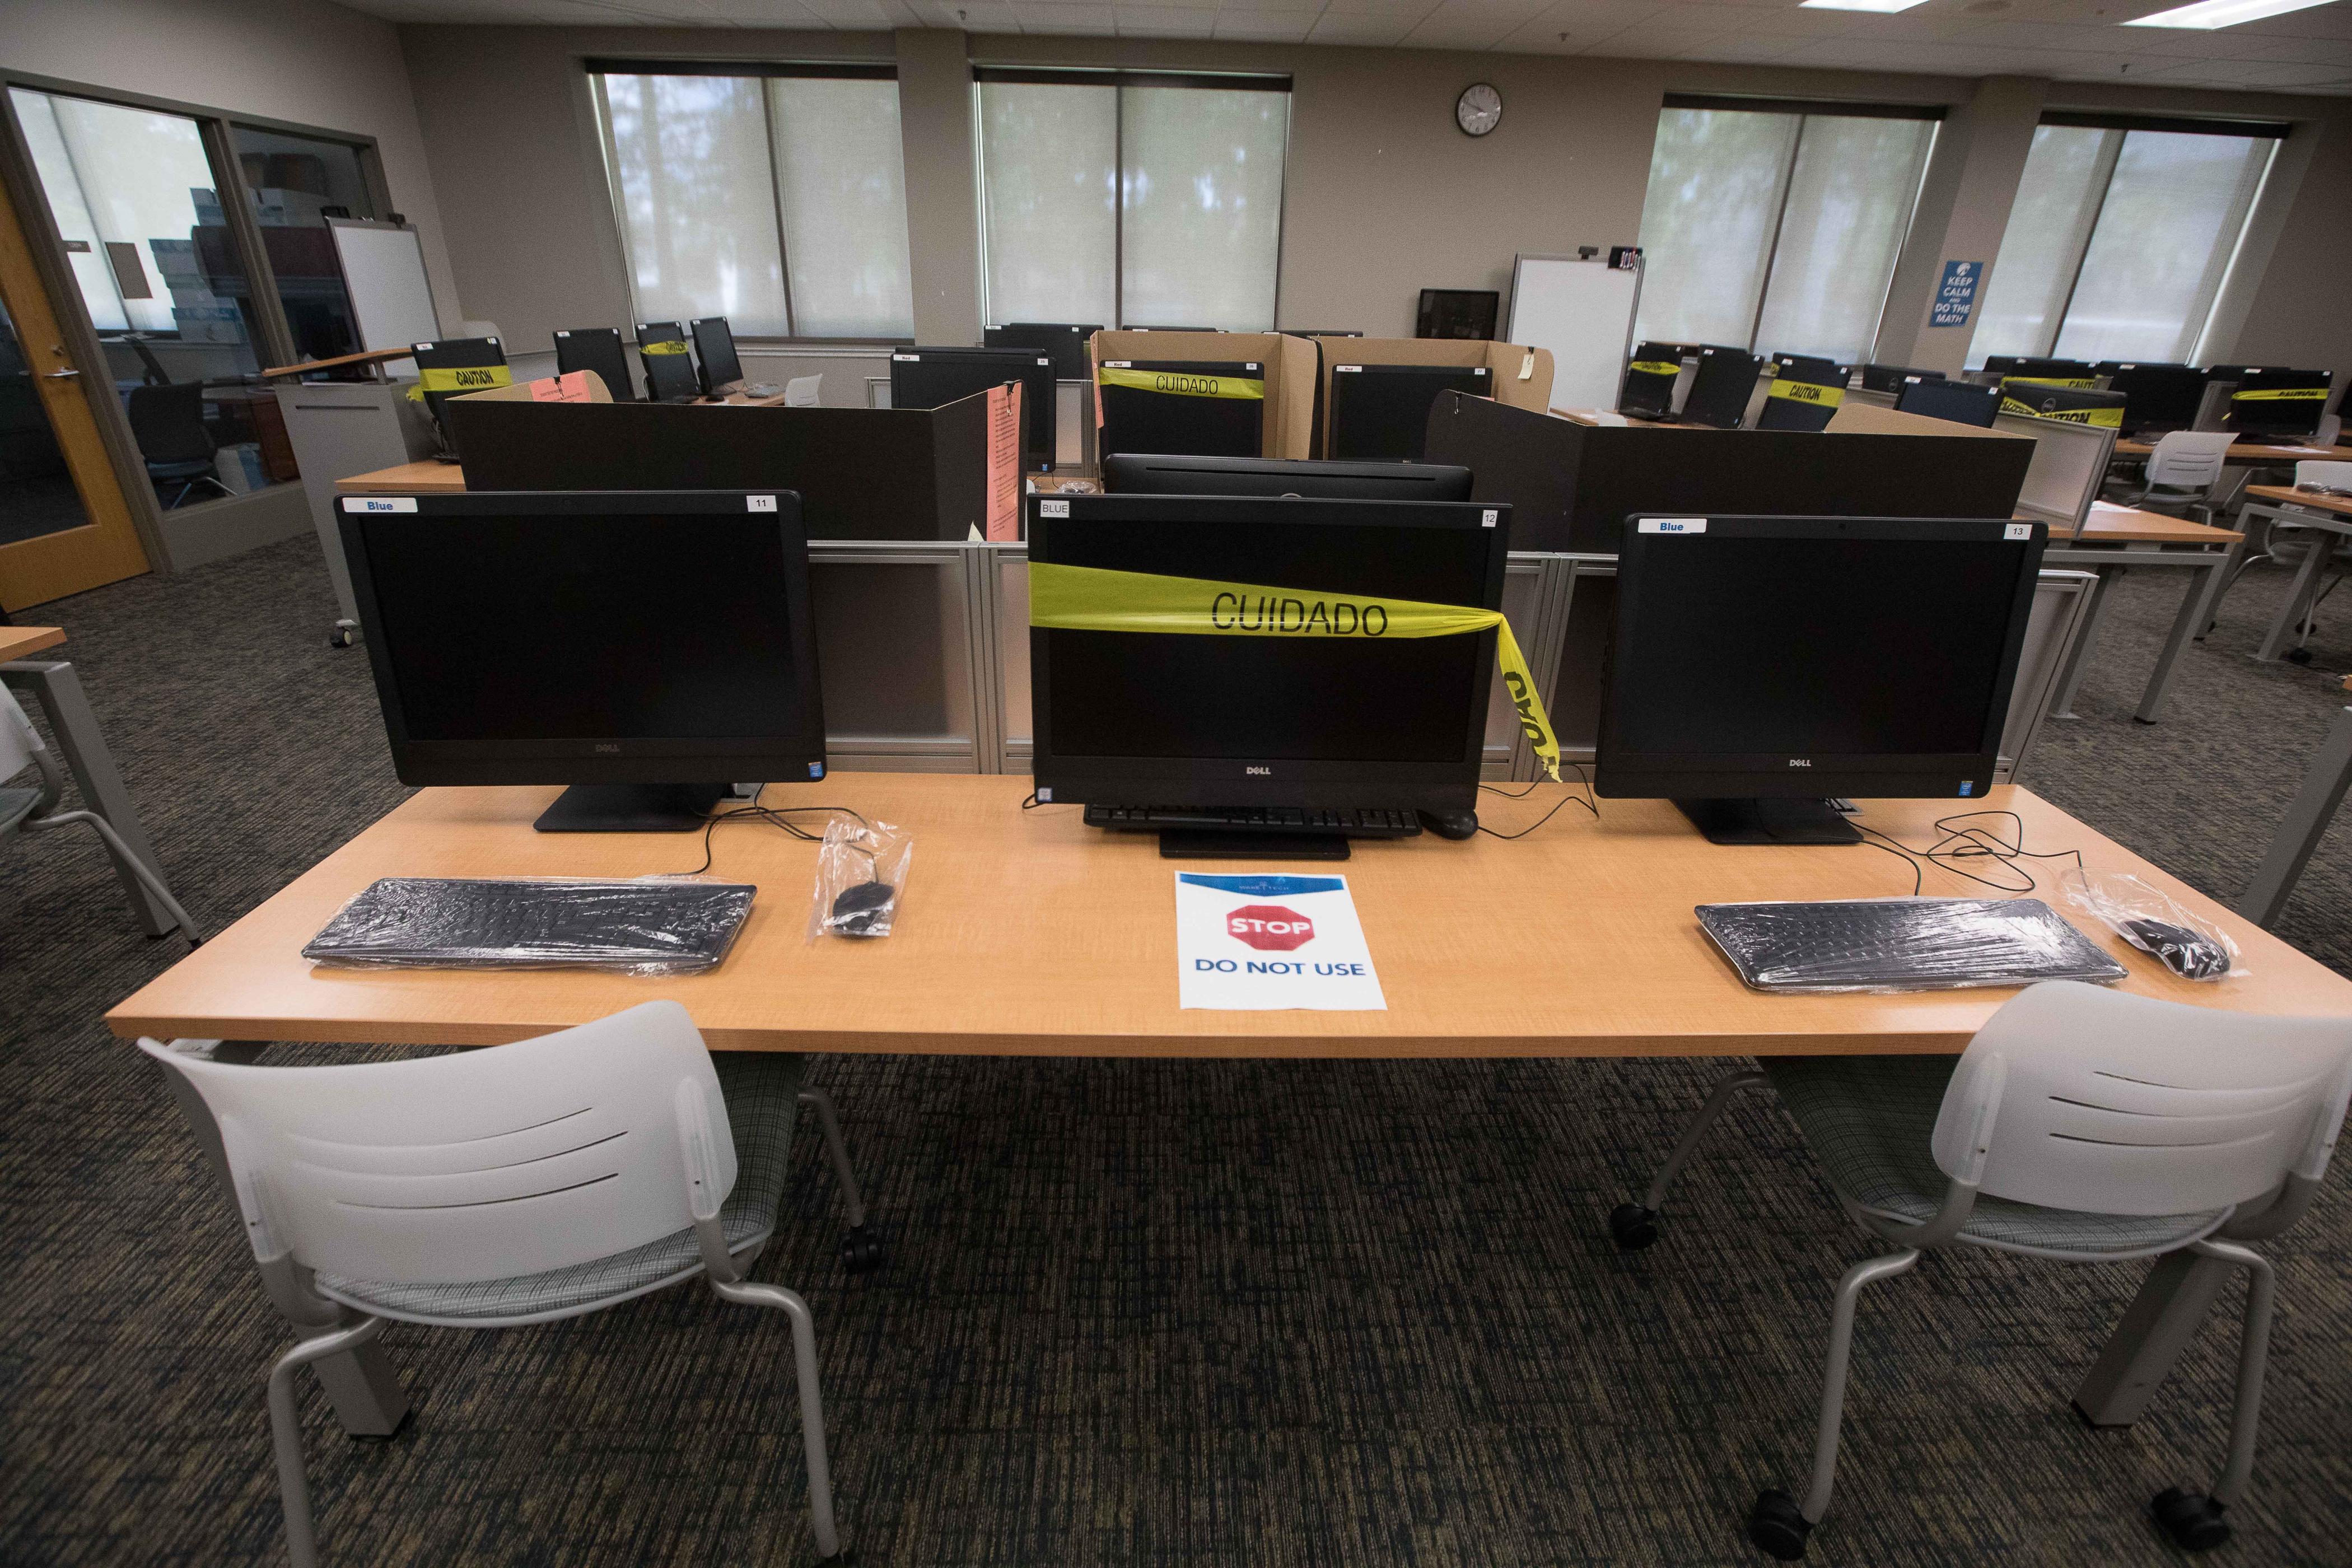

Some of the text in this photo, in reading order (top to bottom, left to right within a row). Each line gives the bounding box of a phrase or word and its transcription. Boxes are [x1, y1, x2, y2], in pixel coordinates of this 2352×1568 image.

[1948, 276, 1973, 286] KEEP
[1943, 287, 1971, 297] CALM
[1935, 303, 1971, 314] DO THE
[1936, 314, 1963, 323] MATH
[456, 370, 494, 386] CAUTION
[1156, 375, 1219, 394] CUIDADO
[1789, 385, 1822, 400] CAUTION
[367, 501, 393, 510] Blue
[1212, 592, 1388, 636] CUIDADO
[595, 744, 620, 752] DELL
[1246, 766, 1271, 774] DELL
[1231, 918, 1310, 935] STOP
[1195, 959, 1366, 976] DO NOT USE
